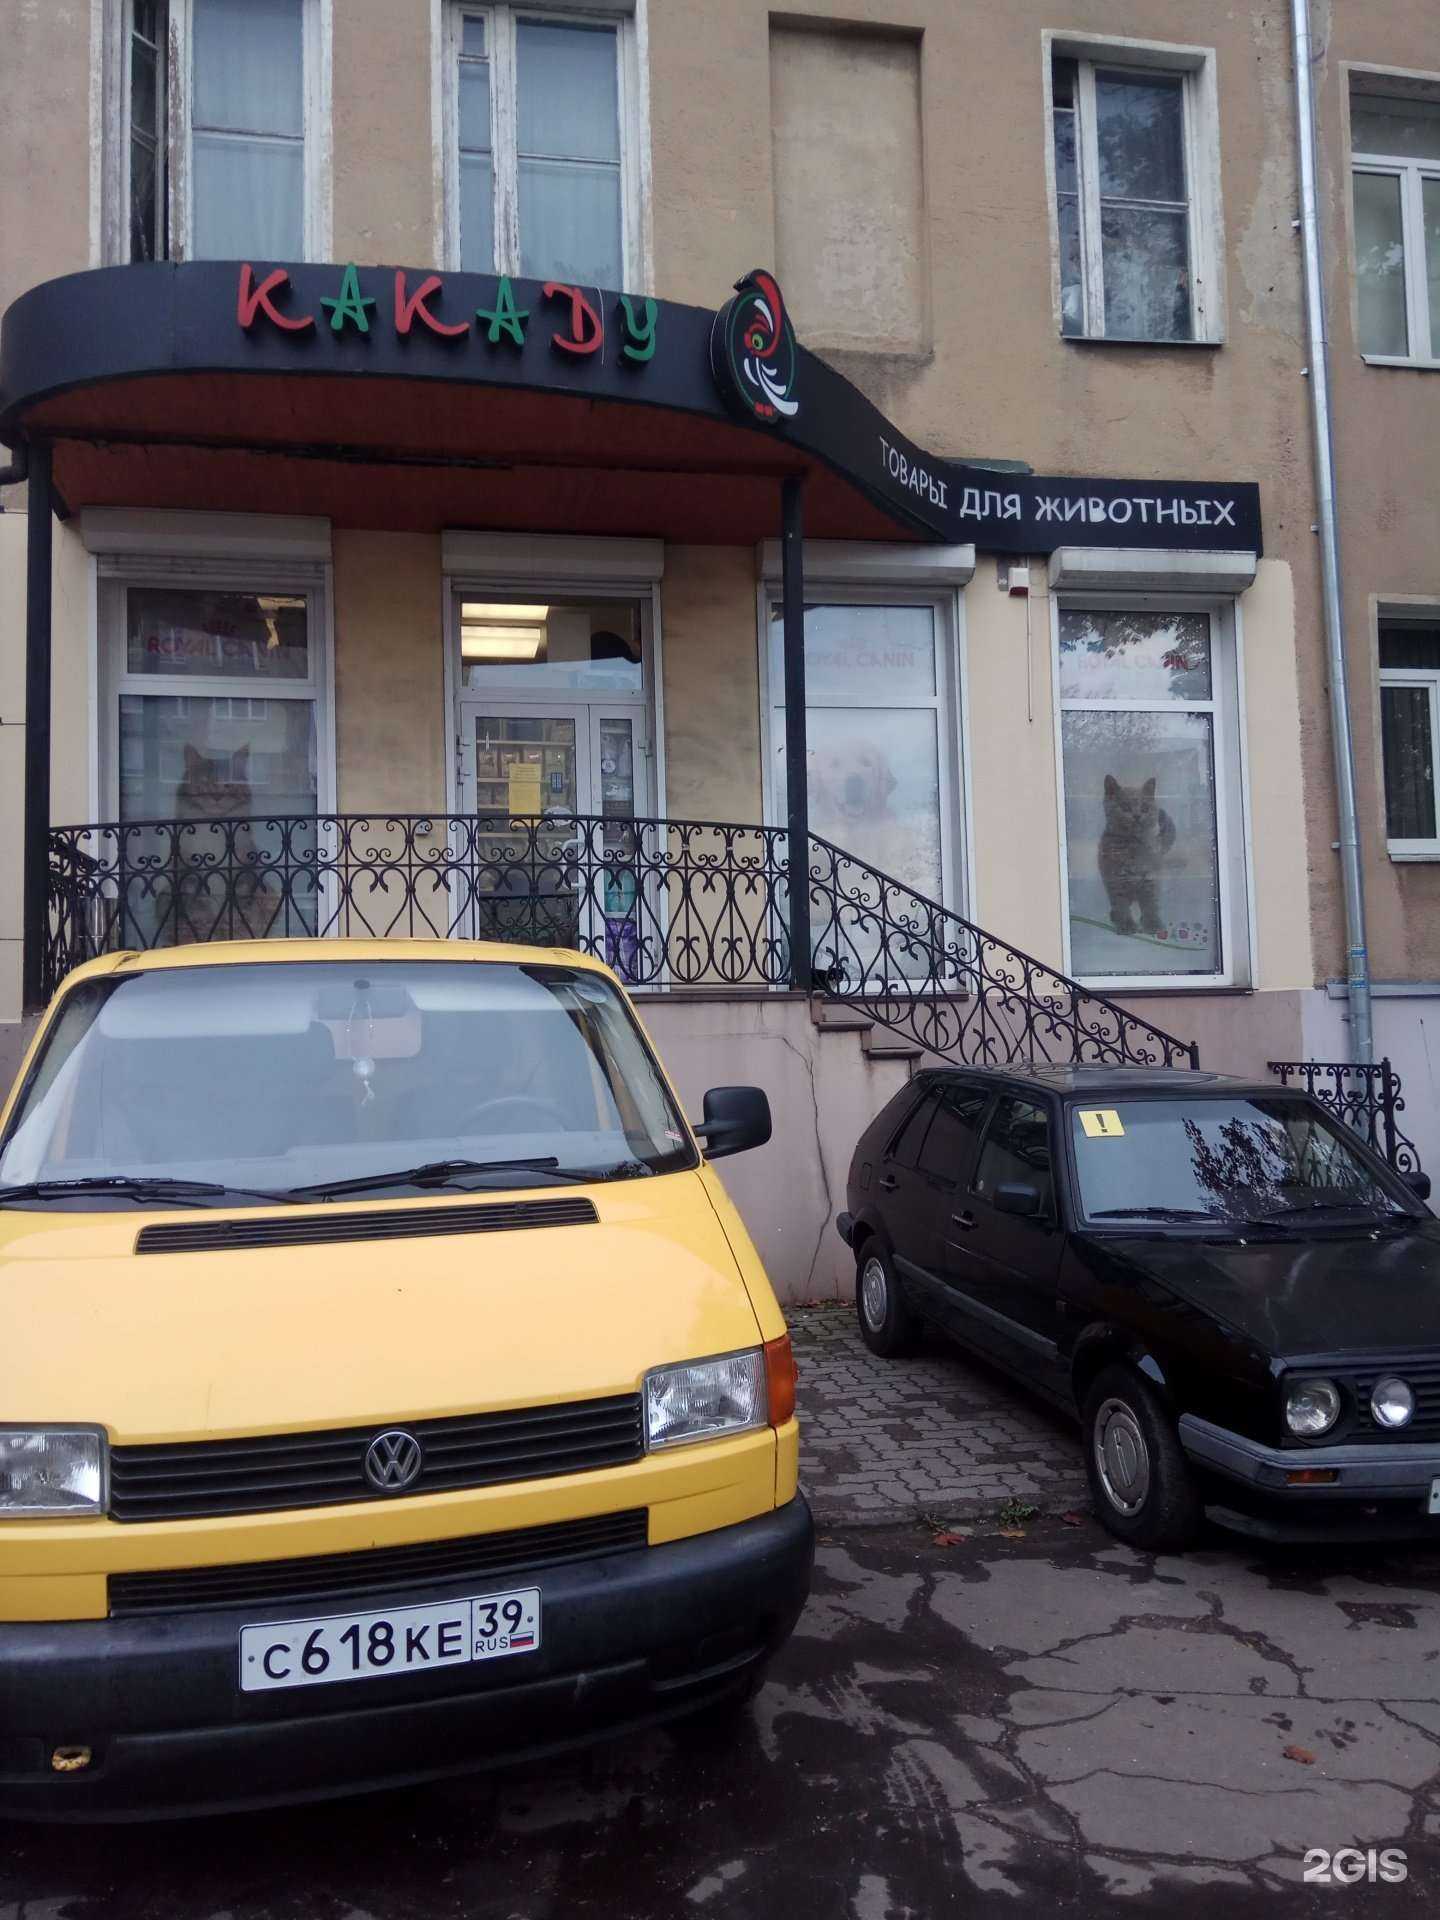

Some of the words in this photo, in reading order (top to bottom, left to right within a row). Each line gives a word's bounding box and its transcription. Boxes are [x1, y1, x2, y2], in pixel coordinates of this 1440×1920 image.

[879, 436, 949, 511] ТОВАРЫ
[959, 487, 1023, 522] ДЛЯ
[1034, 495, 1237, 527] ЖИВОТНЫХ
[263, 1620, 462, 1679] С618КЕ
[478, 1599, 522, 1638] 39
[475, 1637, 508, 1653] RUS
